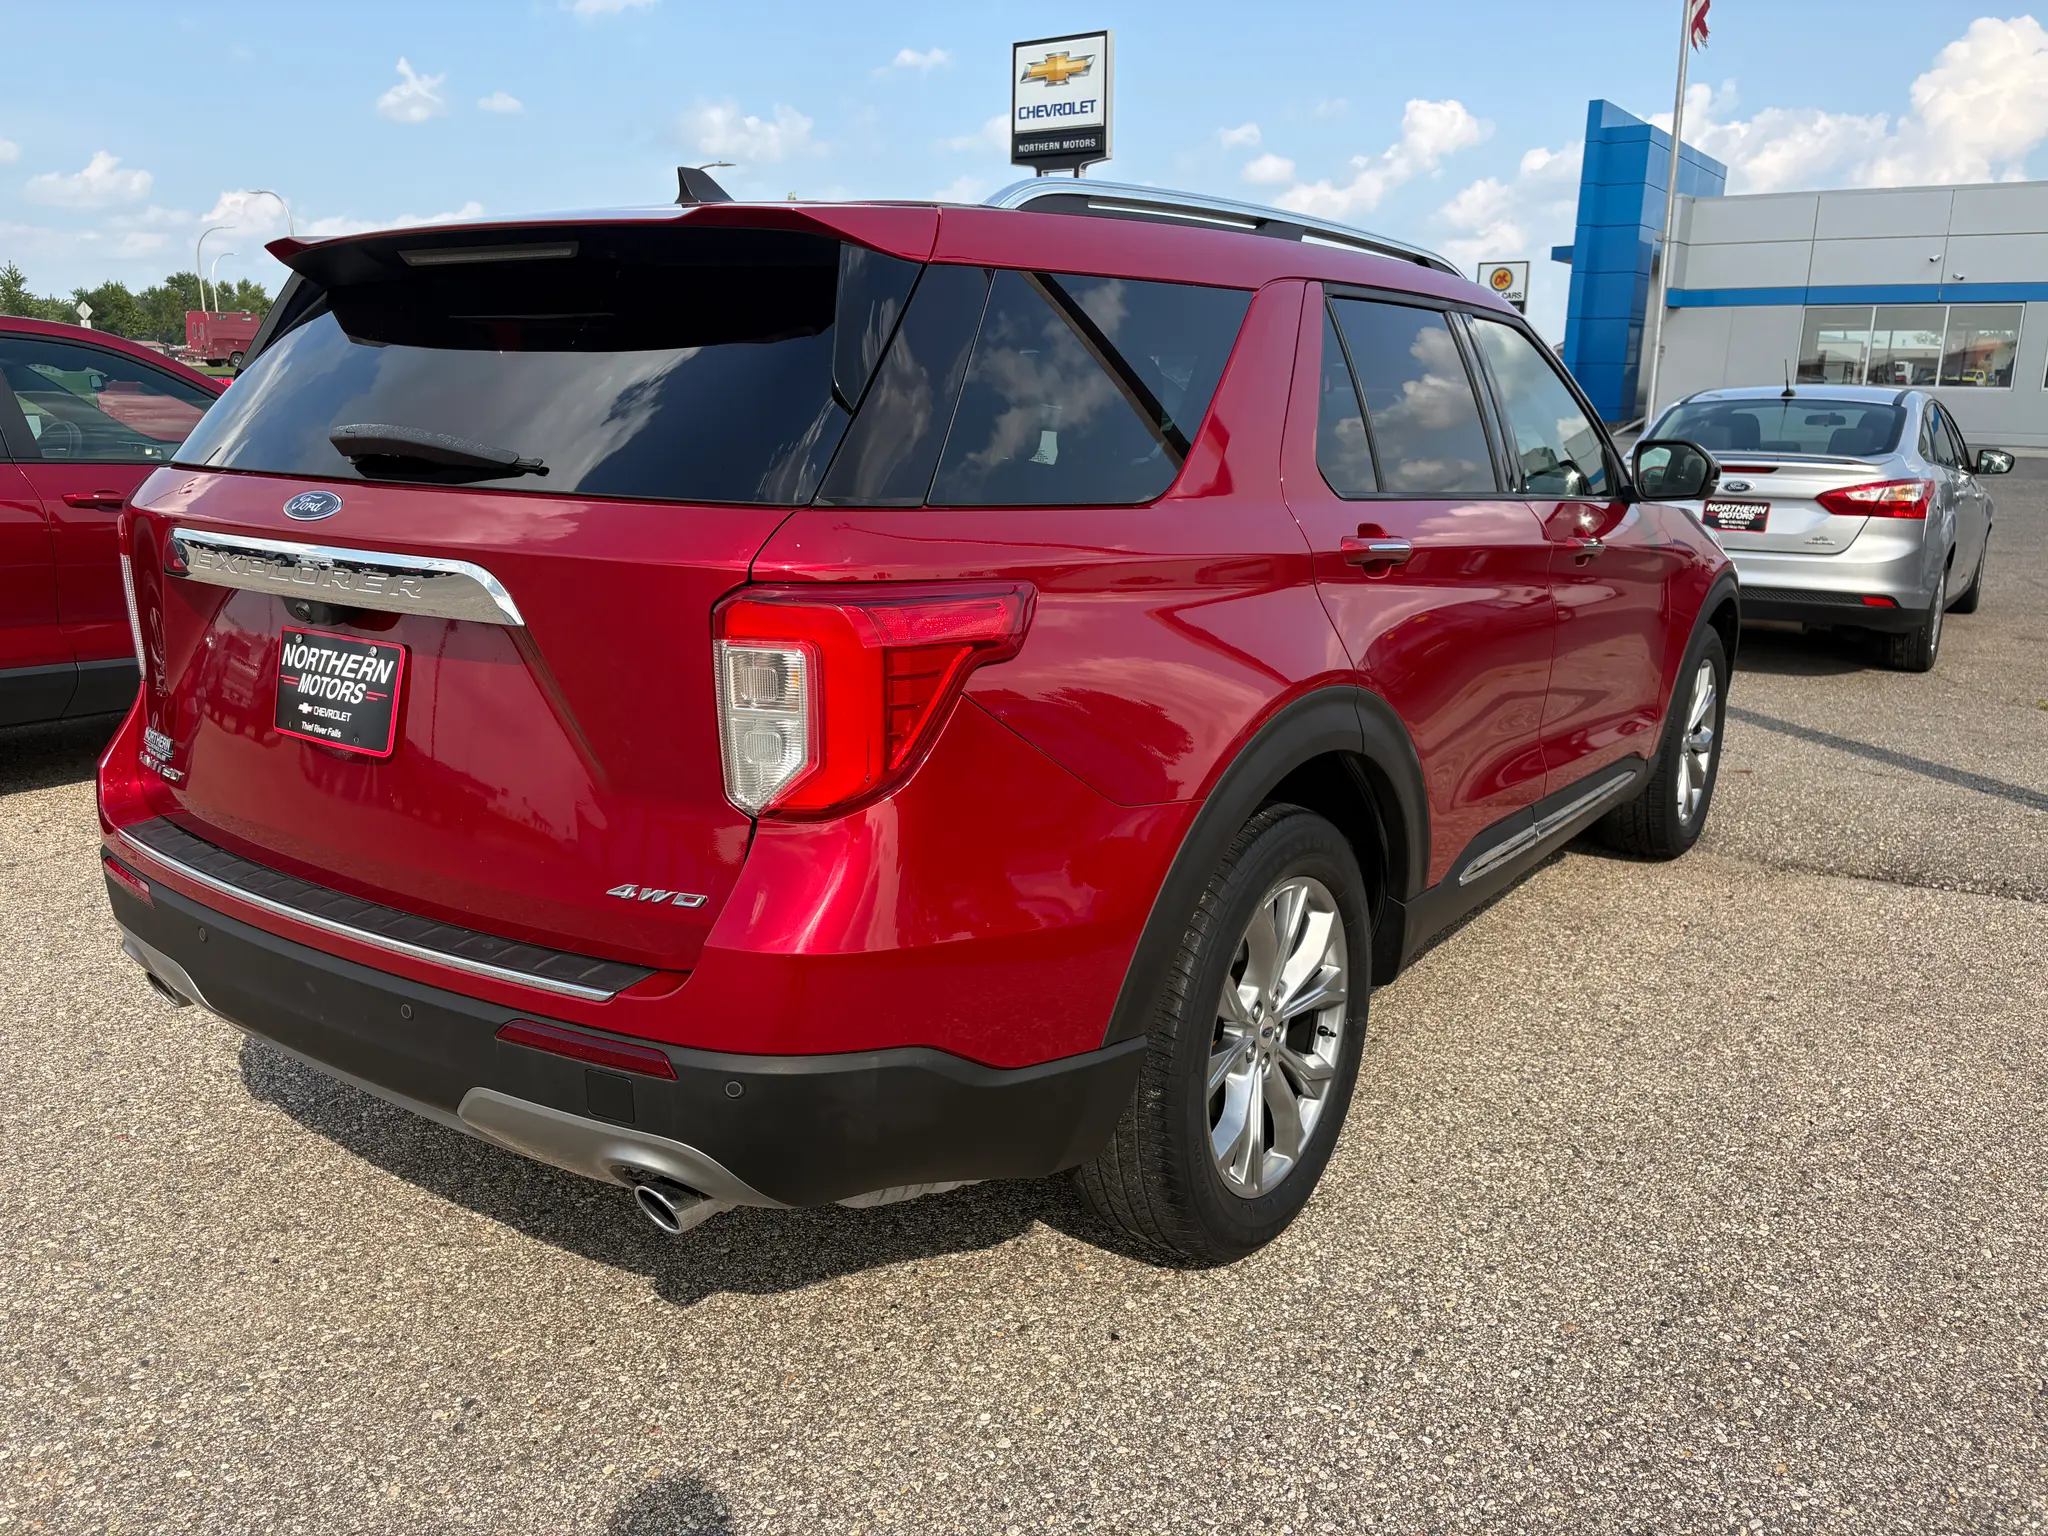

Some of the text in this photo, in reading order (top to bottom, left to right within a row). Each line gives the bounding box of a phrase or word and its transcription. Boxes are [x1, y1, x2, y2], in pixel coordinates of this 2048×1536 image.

[1018, 99, 1097, 120] CHEVROLET
[1018, 138, 1096, 153] NORTHERN MOTORS
[1502, 291, 1522, 299] CARS
[291, 494, 327, 512] Ford
[1706, 503, 1767, 514] NORTHERN
[1717, 511, 1756, 520] MOTORS
[188, 547, 426, 599] EXPLORER
[281, 643, 395, 684] NORTHERN
[297, 672, 367, 704] MOTORS
[313, 705, 352, 722] CHEVROLET
[301, 721, 342, 738] Thief River Falls
[605, 883, 708, 908] 4WD
